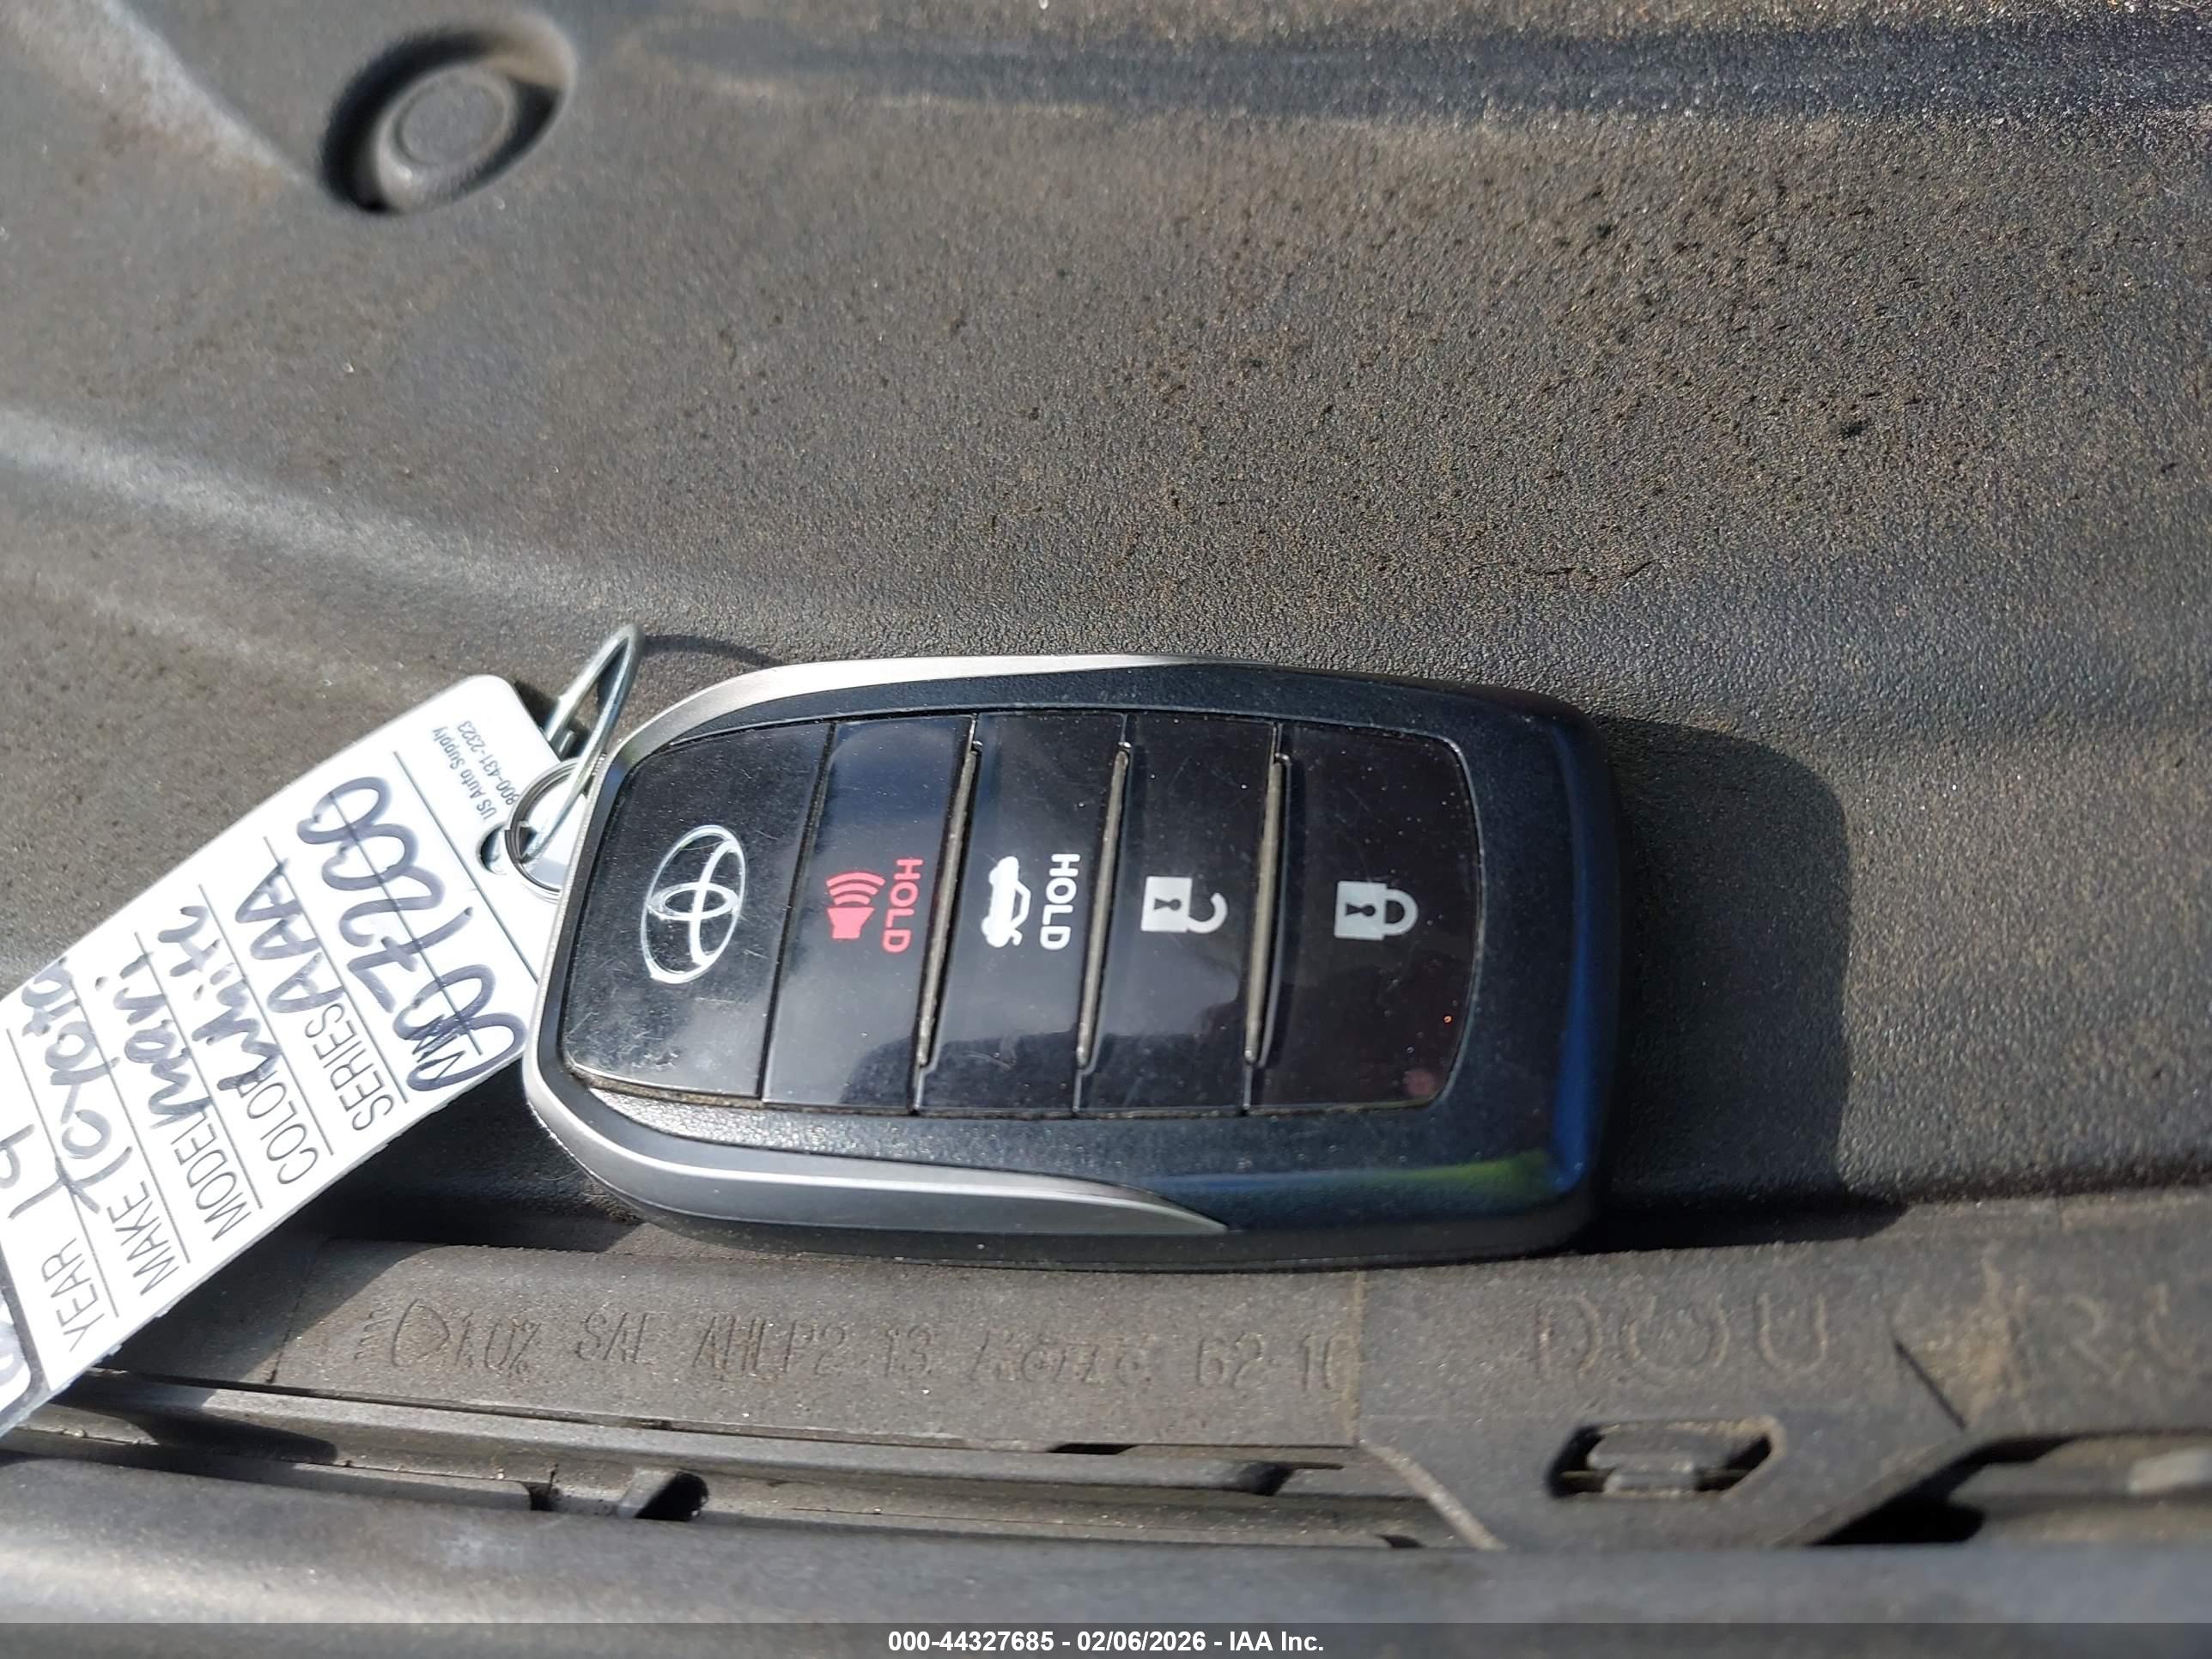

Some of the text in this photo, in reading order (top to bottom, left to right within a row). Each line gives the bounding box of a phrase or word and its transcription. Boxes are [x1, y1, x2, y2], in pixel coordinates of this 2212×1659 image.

[432, 726, 497, 820] US Auto Supply
[457, 720, 520, 805] 800-431-2323
[235, 858, 344, 1014] AAA
[881, 859, 924, 953] HOLD
[1039, 853, 1081, 950] HOLD
[304, 1002, 396, 1132] SERIES
[170, 1110, 252, 1242] MODEL
[40, 1237, 106, 1352] YEAR
[106, 1181, 180, 1297] MAKE
